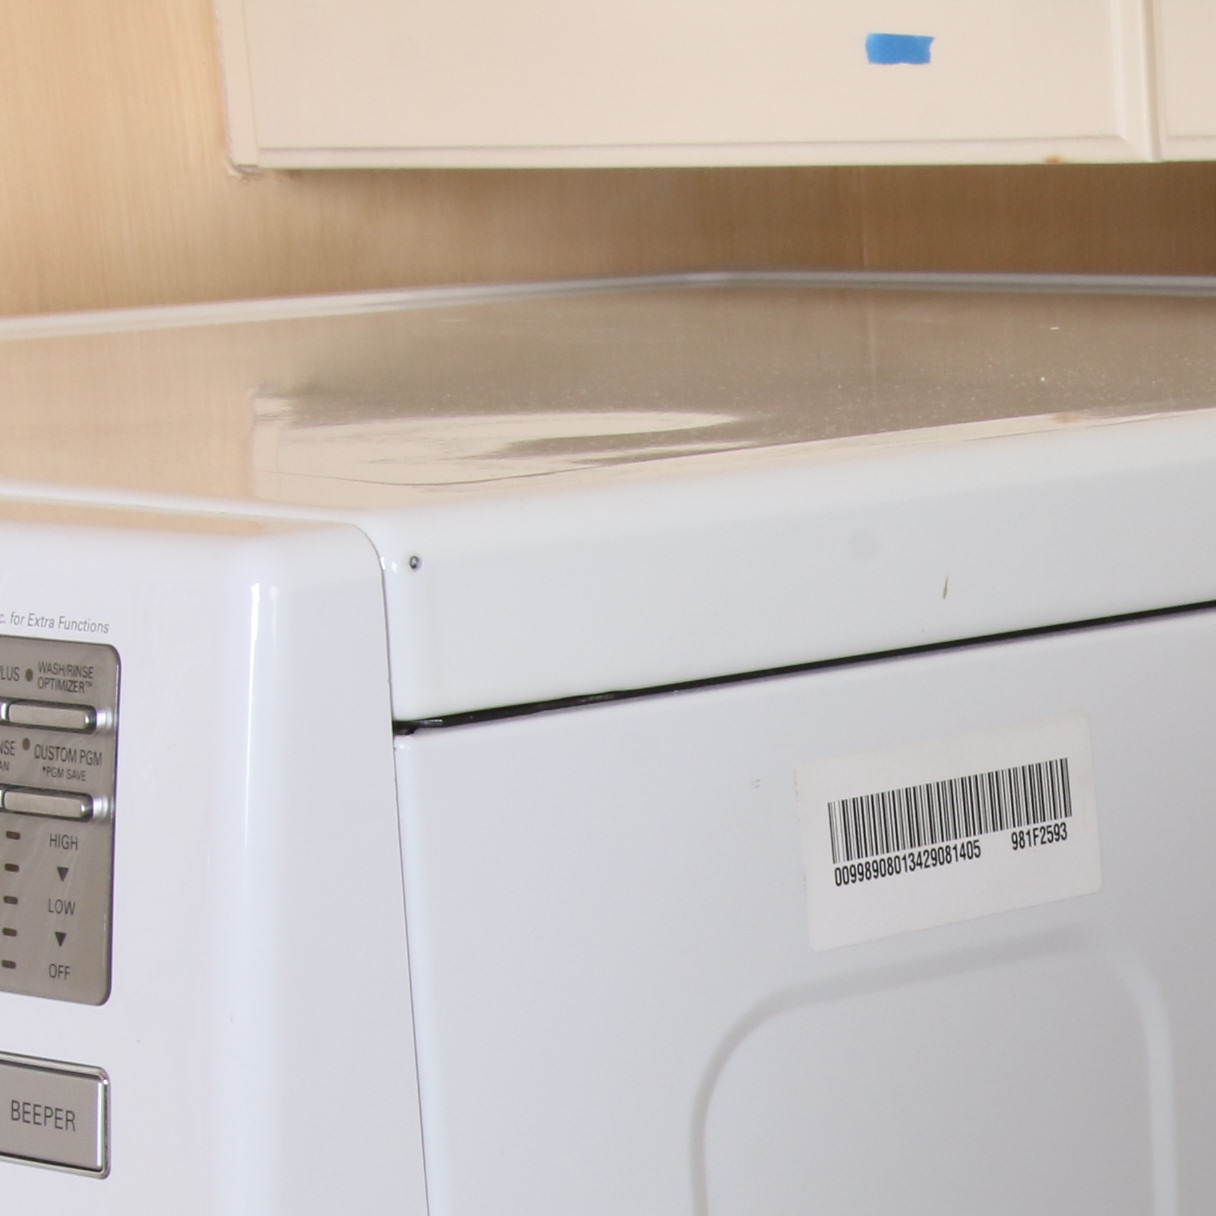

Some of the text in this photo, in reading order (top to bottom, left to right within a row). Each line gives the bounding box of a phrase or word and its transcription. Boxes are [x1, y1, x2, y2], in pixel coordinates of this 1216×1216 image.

[10, 611, 25, 625] for
[27, 613, 55, 629] Extra
[58, 616, 110, 634] Functions
[34, 744, 103, 767] CUSTOM PGM
[66, 769, 86, 782] SAVE
[49, 833, 78, 851] HIGH
[834, 821, 1068, 887] 00998908013429081405 981F2593
[48, 898, 76, 916] LOW
[49, 963, 71, 980] OFF
[11, 1099, 76, 1132] BEEPER
